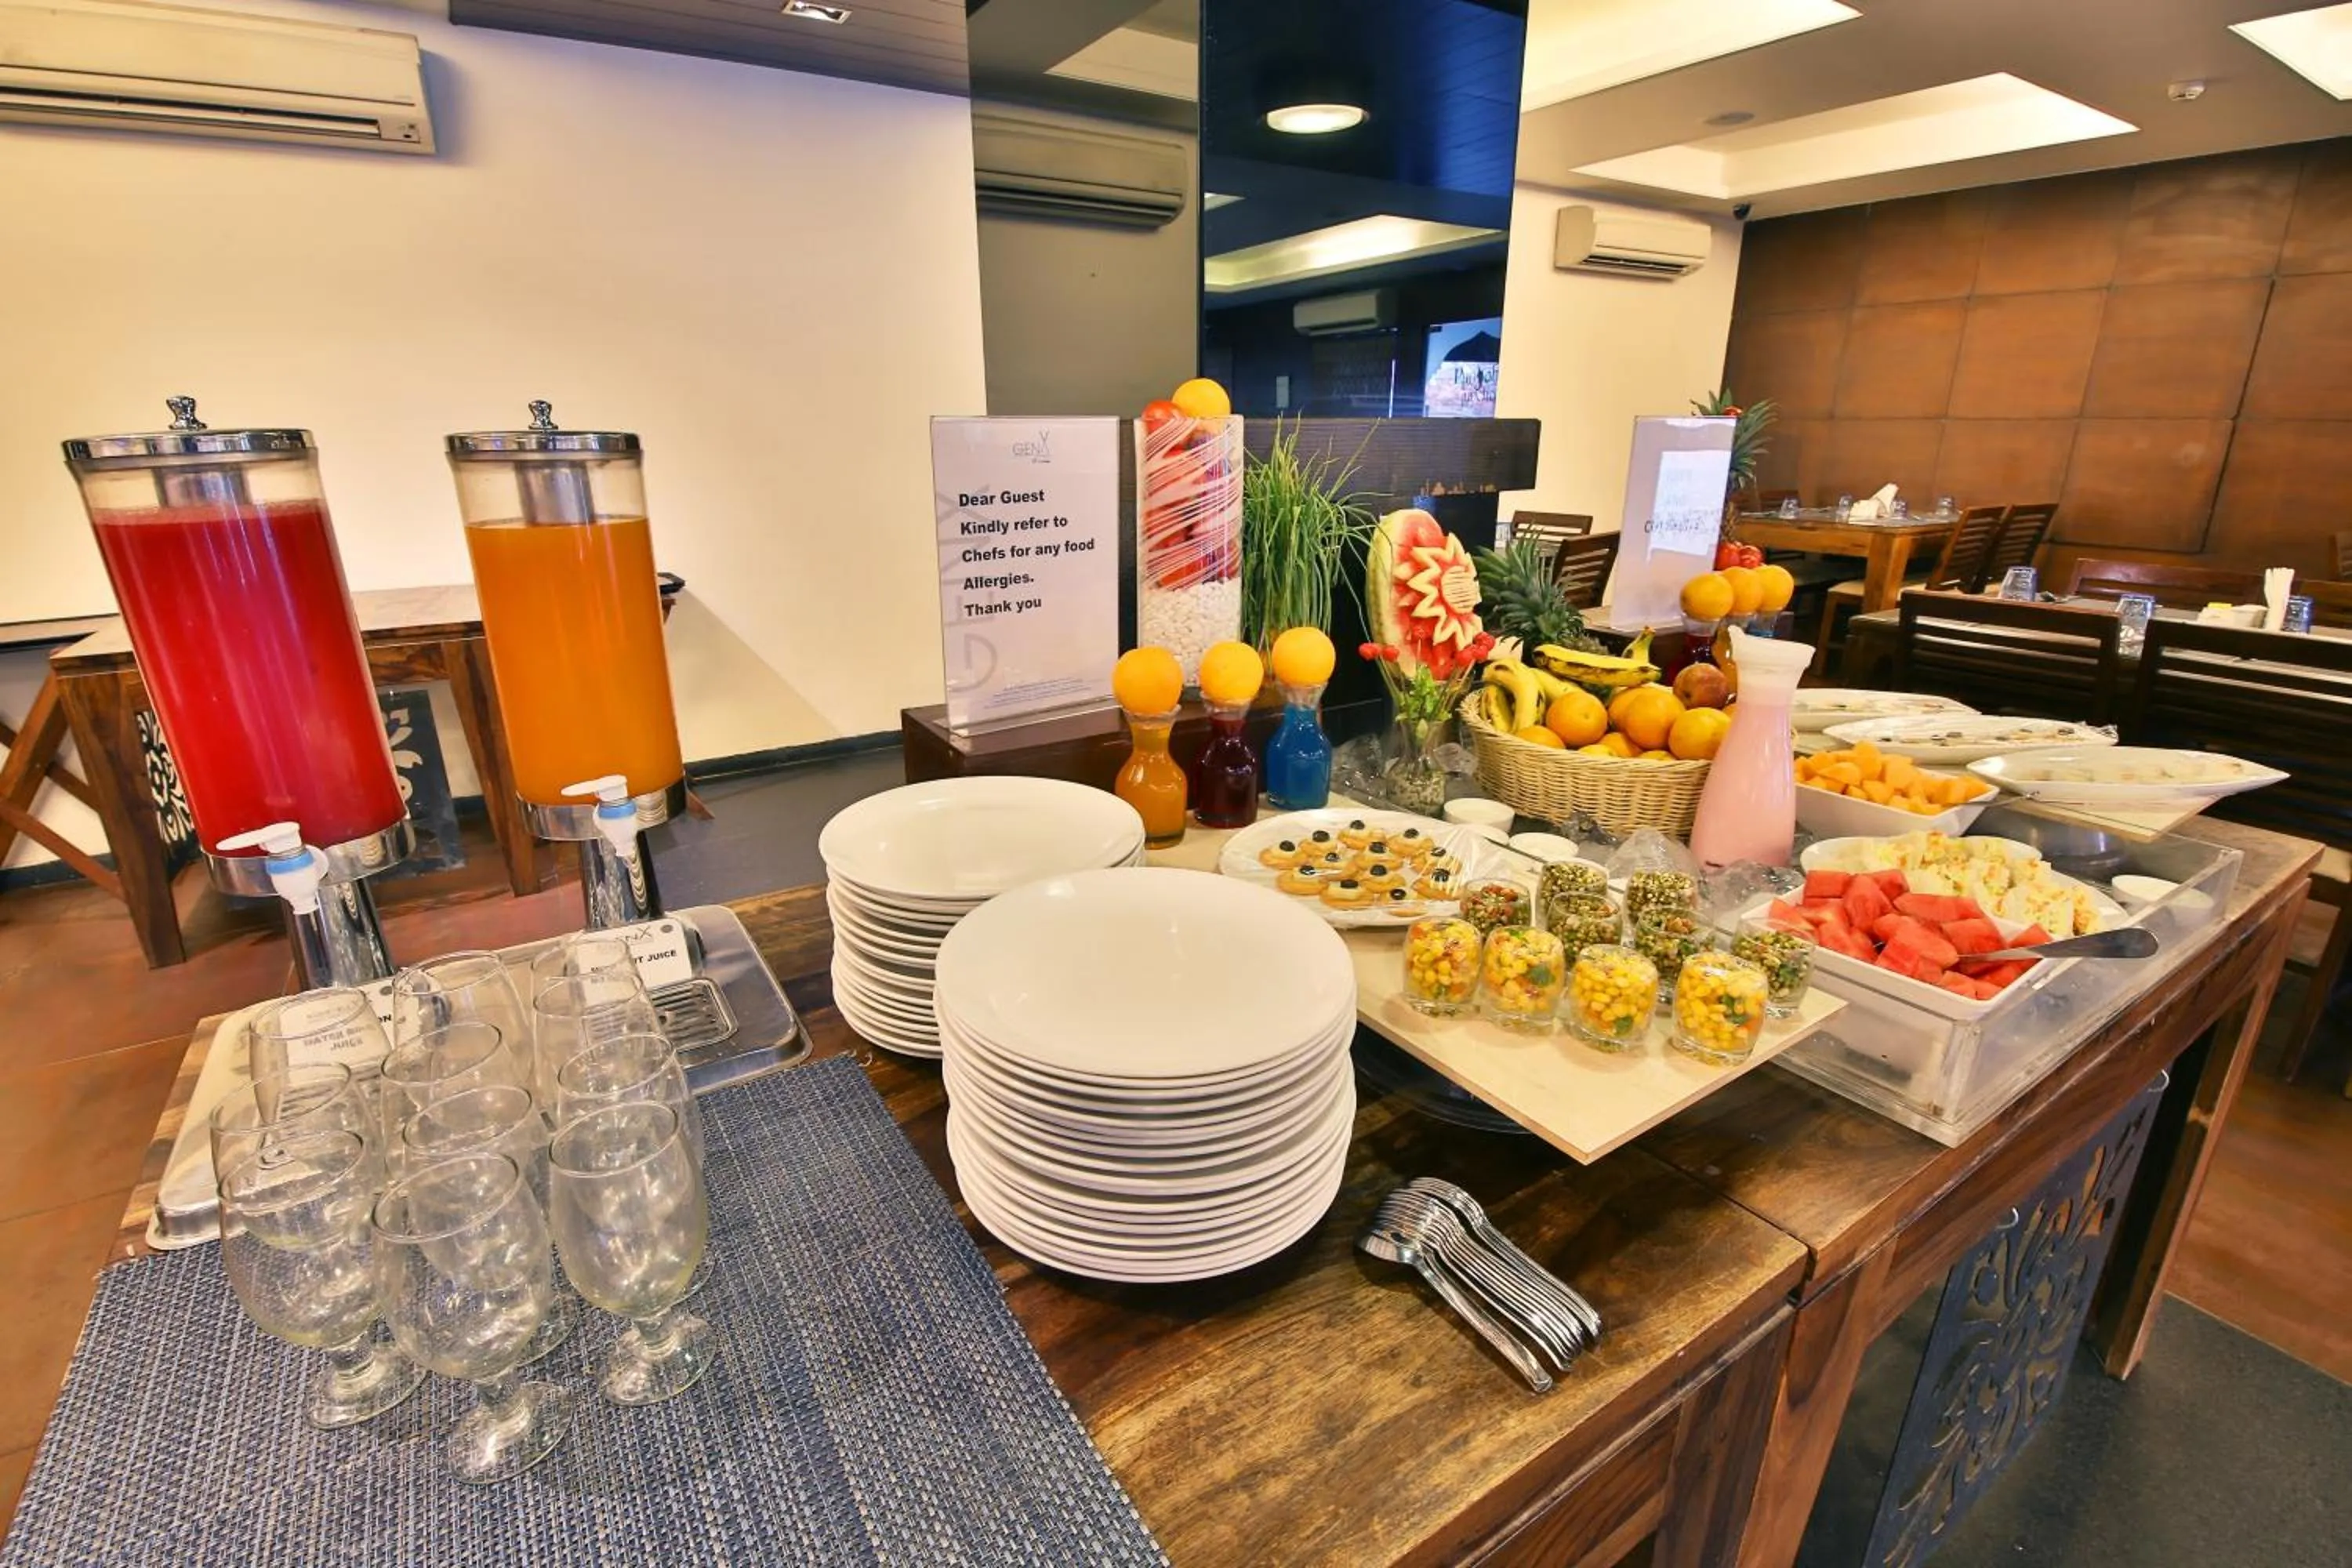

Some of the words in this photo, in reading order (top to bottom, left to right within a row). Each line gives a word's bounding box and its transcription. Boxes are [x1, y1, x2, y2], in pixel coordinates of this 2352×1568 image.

[959, 492, 996, 507] Dear
[1000, 488, 1045, 504] Guest
[960, 520, 1009, 535] Kindly
[1014, 516, 1049, 531] refer
[1053, 515, 1068, 528] to
[962, 547, 1006, 563] Chefs
[1010, 545, 1031, 558] for
[1035, 543, 1061, 557] any
[1064, 538, 1095, 553] food
[963, 572, 1035, 590] Allergies.
[964, 600, 1012, 617] Thank
[1016, 597, 1042, 613] you
[647, 949, 677, 962] JUICE
